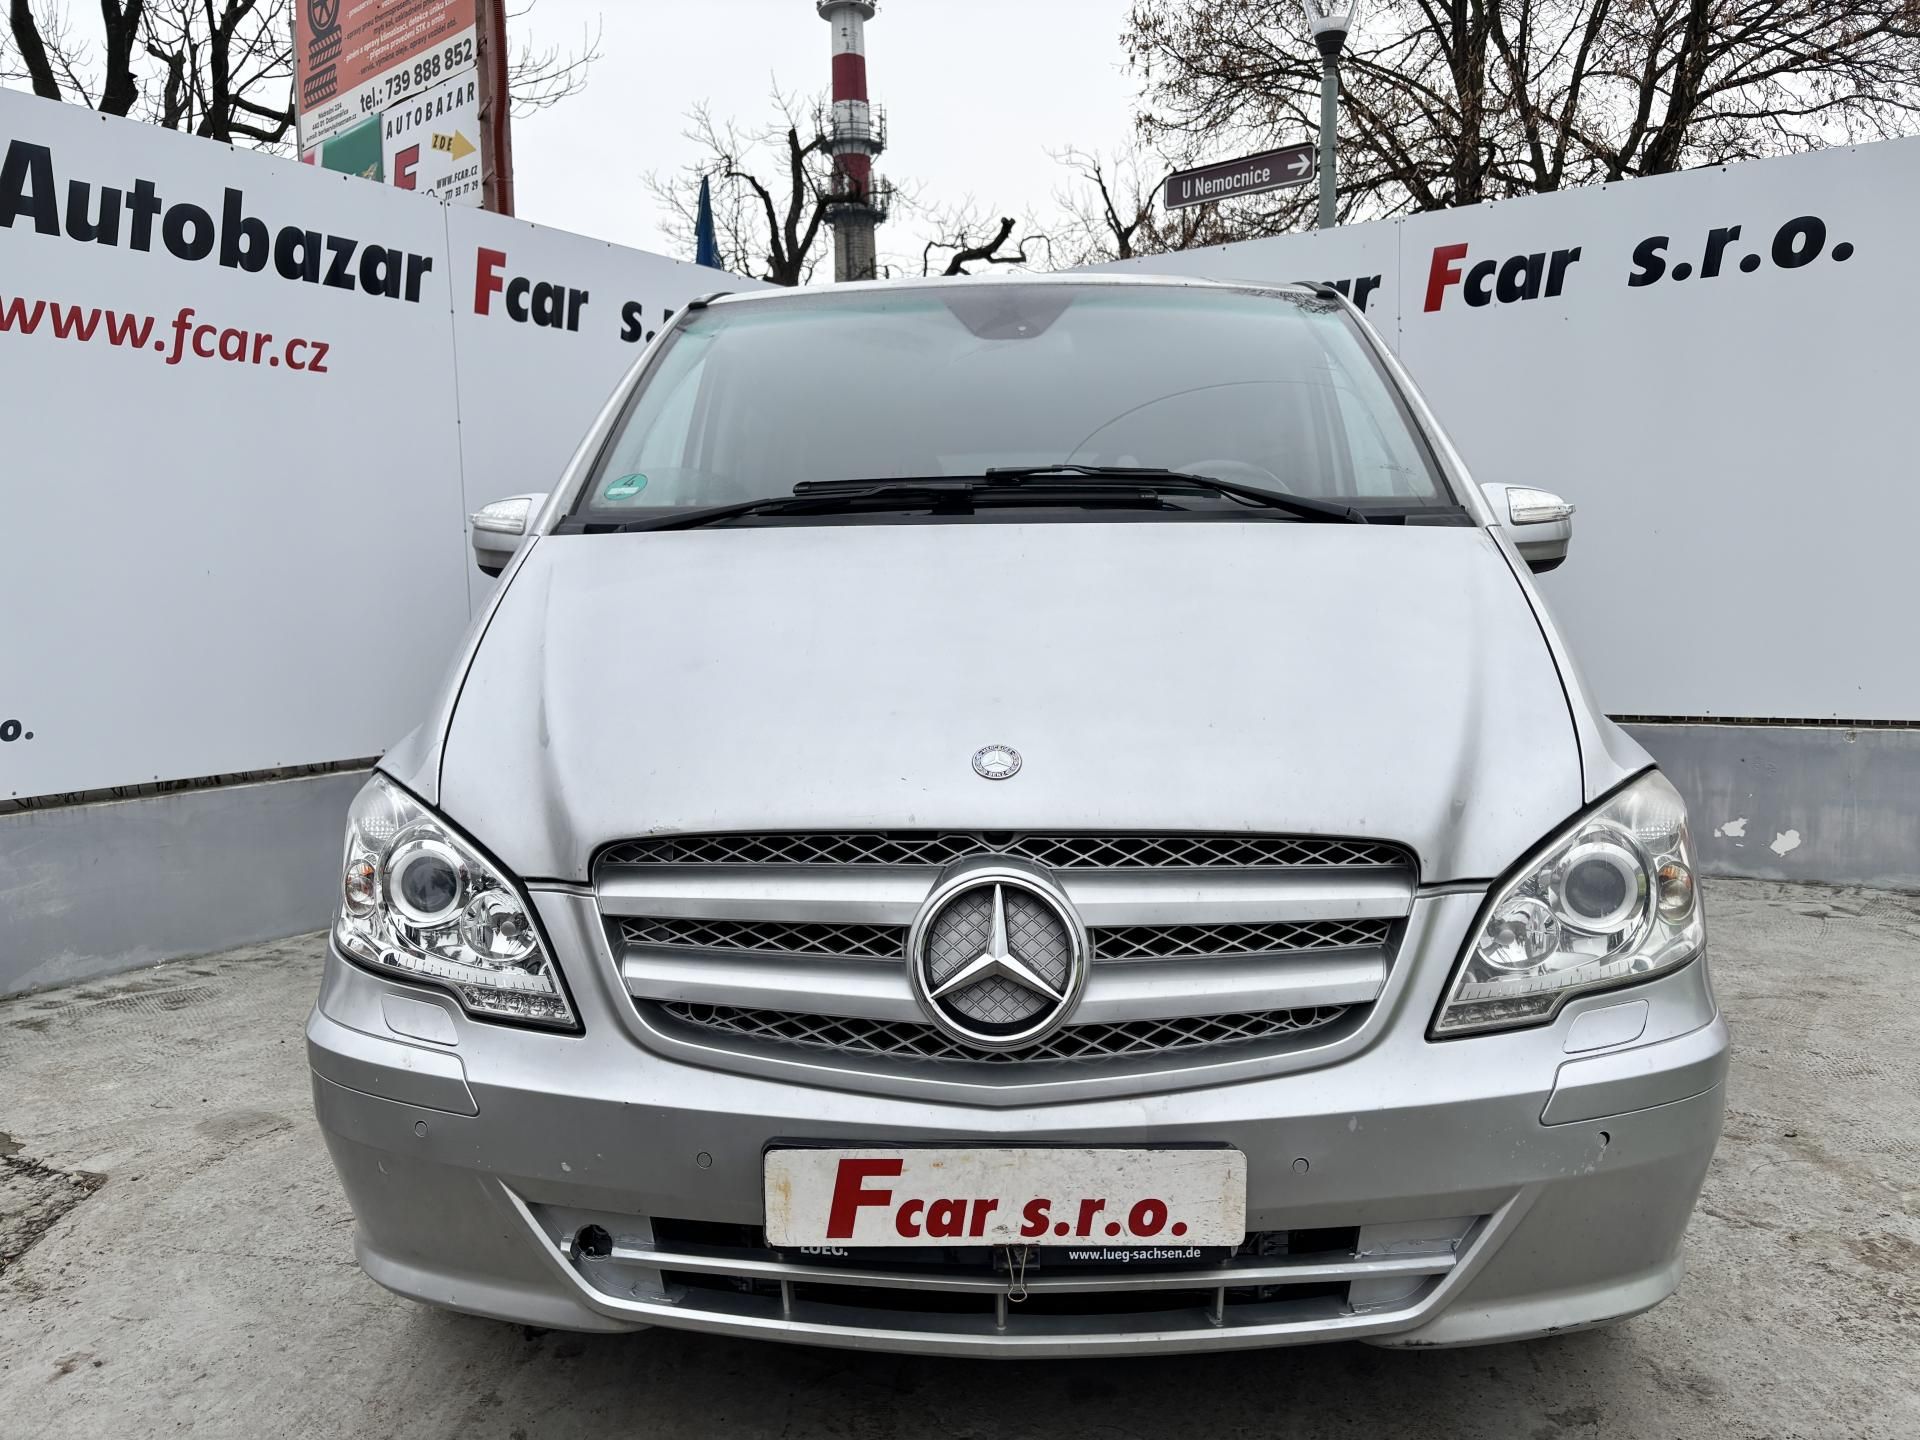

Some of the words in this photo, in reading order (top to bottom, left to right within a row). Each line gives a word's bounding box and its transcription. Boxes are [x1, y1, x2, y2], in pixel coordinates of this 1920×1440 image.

[360, 87, 383, 112] tel.:
[385, 70, 410, 100] 739
[414, 54, 441, 86] 888
[444, 38, 473, 70] 852
[386, 82, 475, 140] AUTOBAZAR
[433, 134, 452, 151] ZDE
[437, 165, 478, 189] WWW.FCAR.CZ
[1182, 180, 1191, 199] U
[1195, 166, 1271, 197] Nemocnice
[0, 139, 433, 303] Autobazar
[473, 246, 589, 333] Fcar
[1424, 243, 1580, 313] Fcar
[1629, 215, 1854, 287] s.r.o.
[0, 296, 330, 374] www.fcar.cz
[826, 1159, 998, 1238] Fcar
[1020, 1198, 1188, 1238] s.r.o.
[1068, 1247, 1201, 1262] www.lueg-sachsen.de
